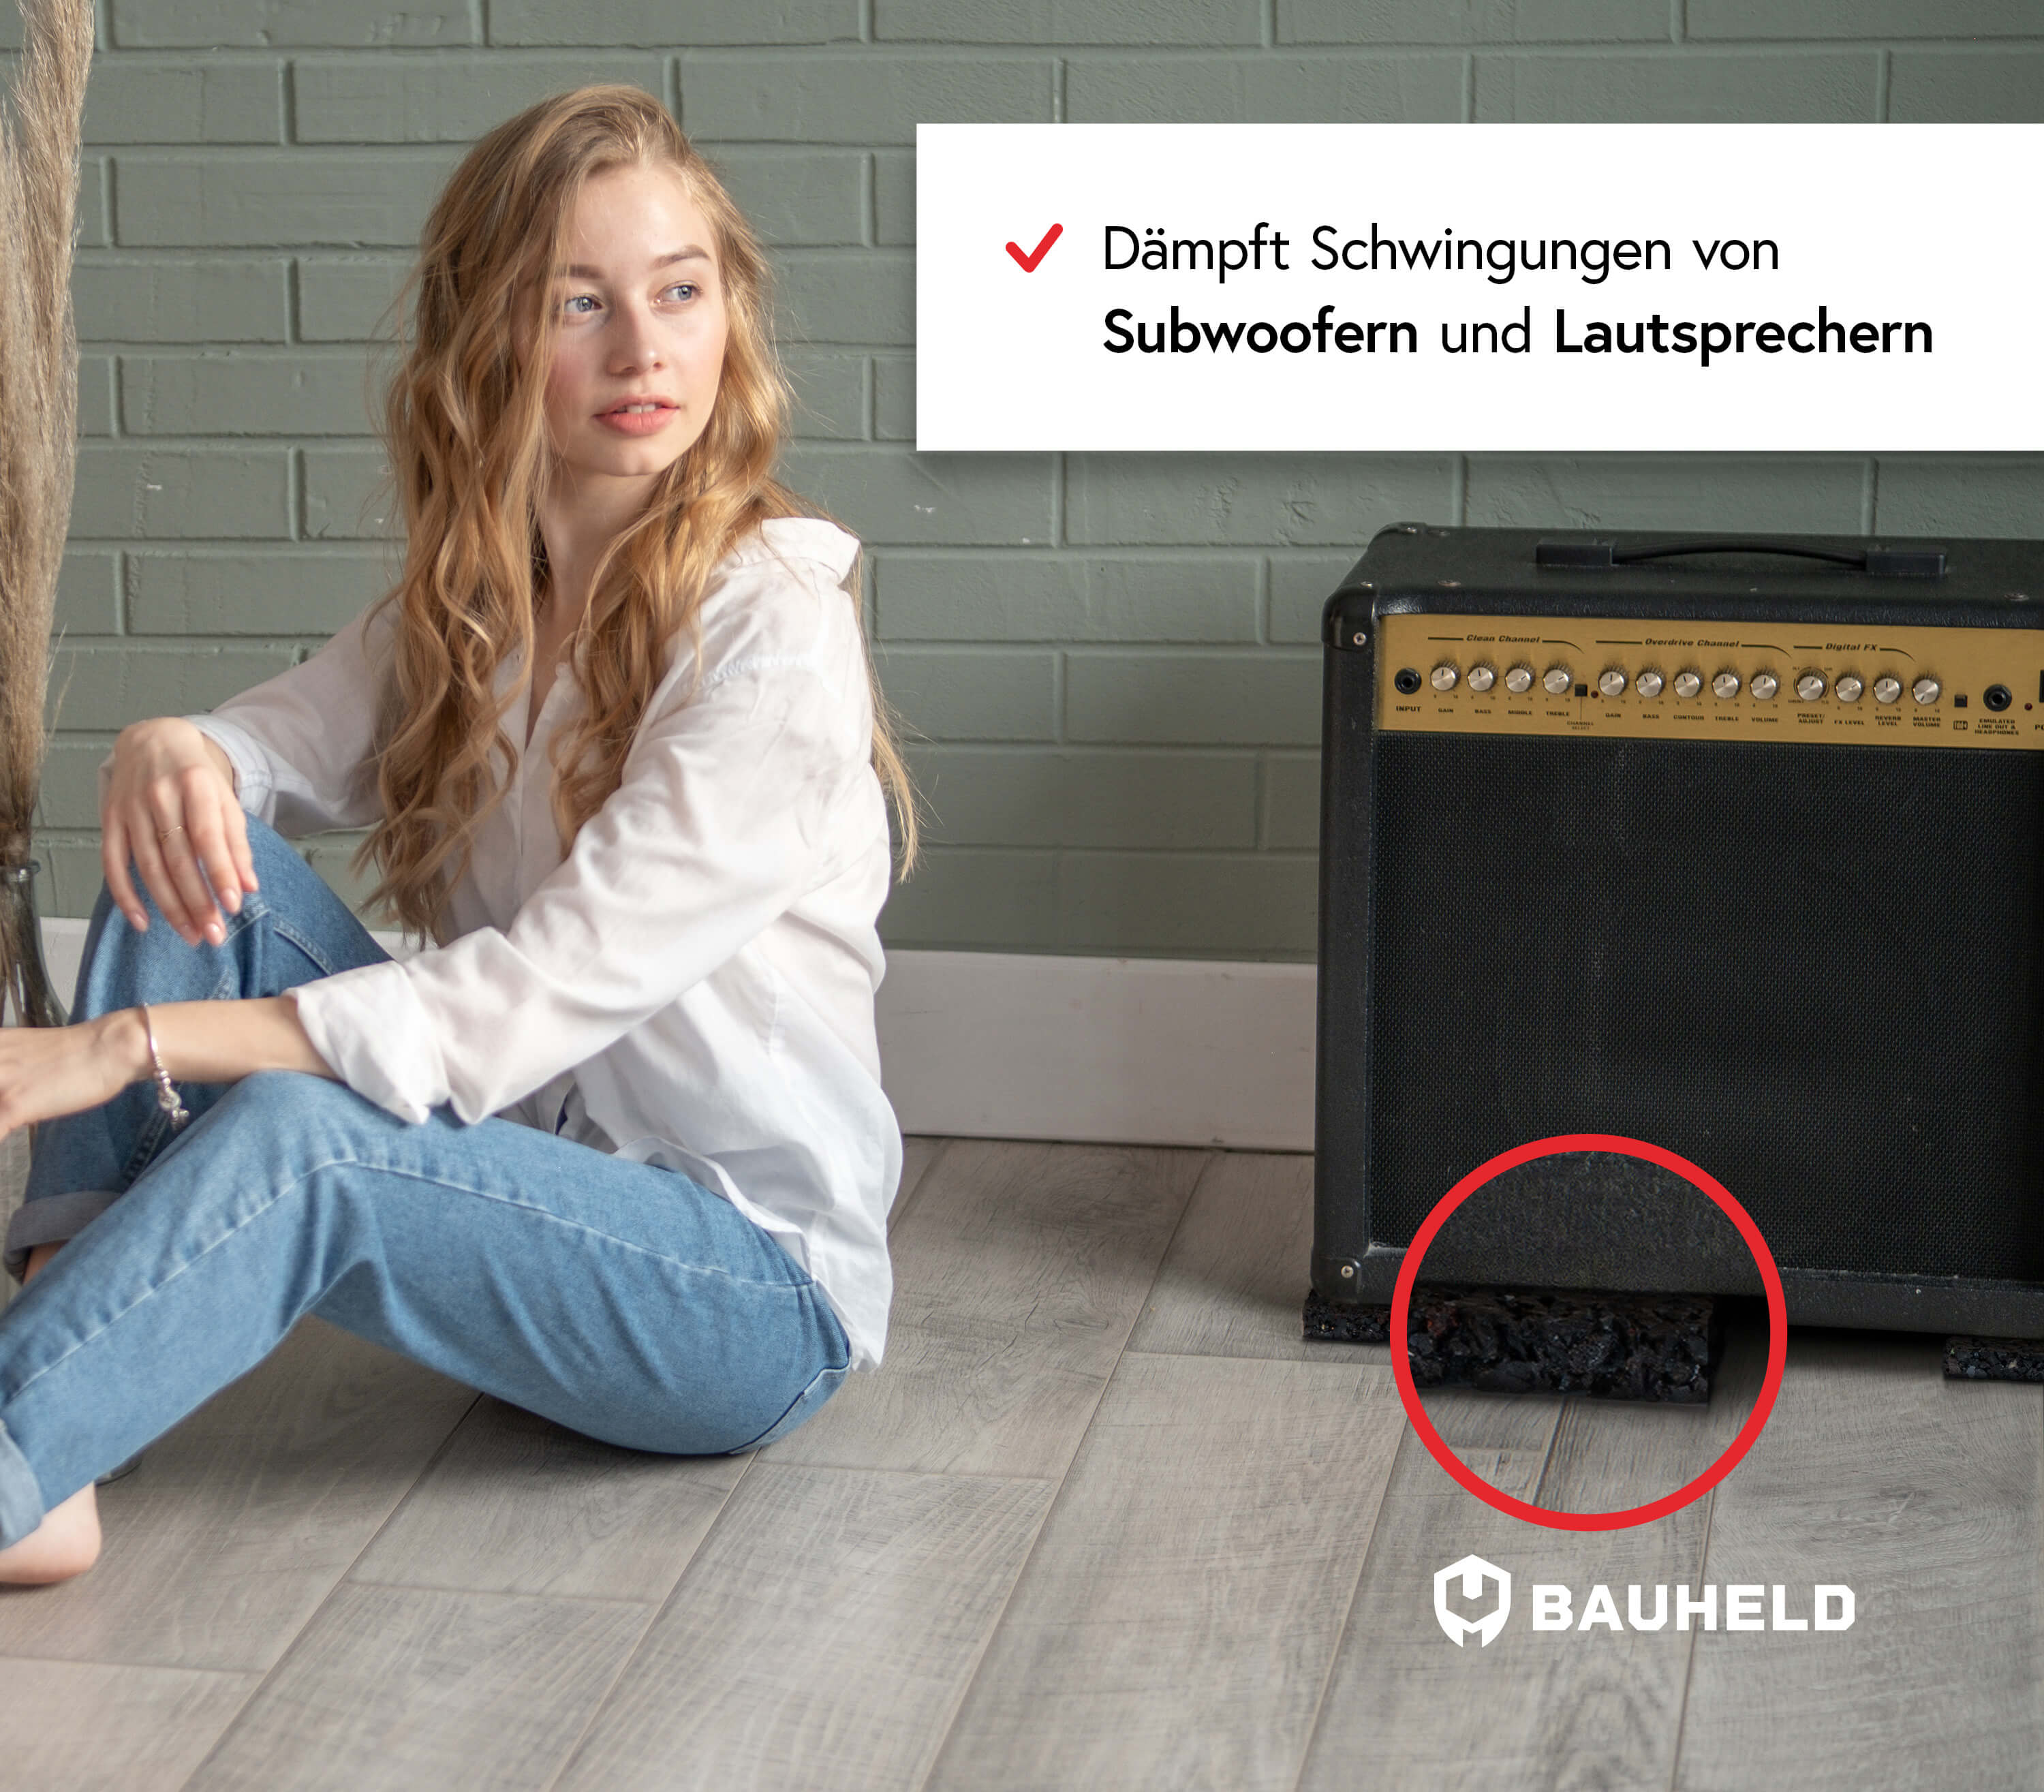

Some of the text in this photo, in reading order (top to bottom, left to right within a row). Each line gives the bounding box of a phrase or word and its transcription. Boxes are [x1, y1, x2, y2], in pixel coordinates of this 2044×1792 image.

[1645, 638, 1739, 647] Overdrive Channel
[1825, 643, 1861, 651] Digital
